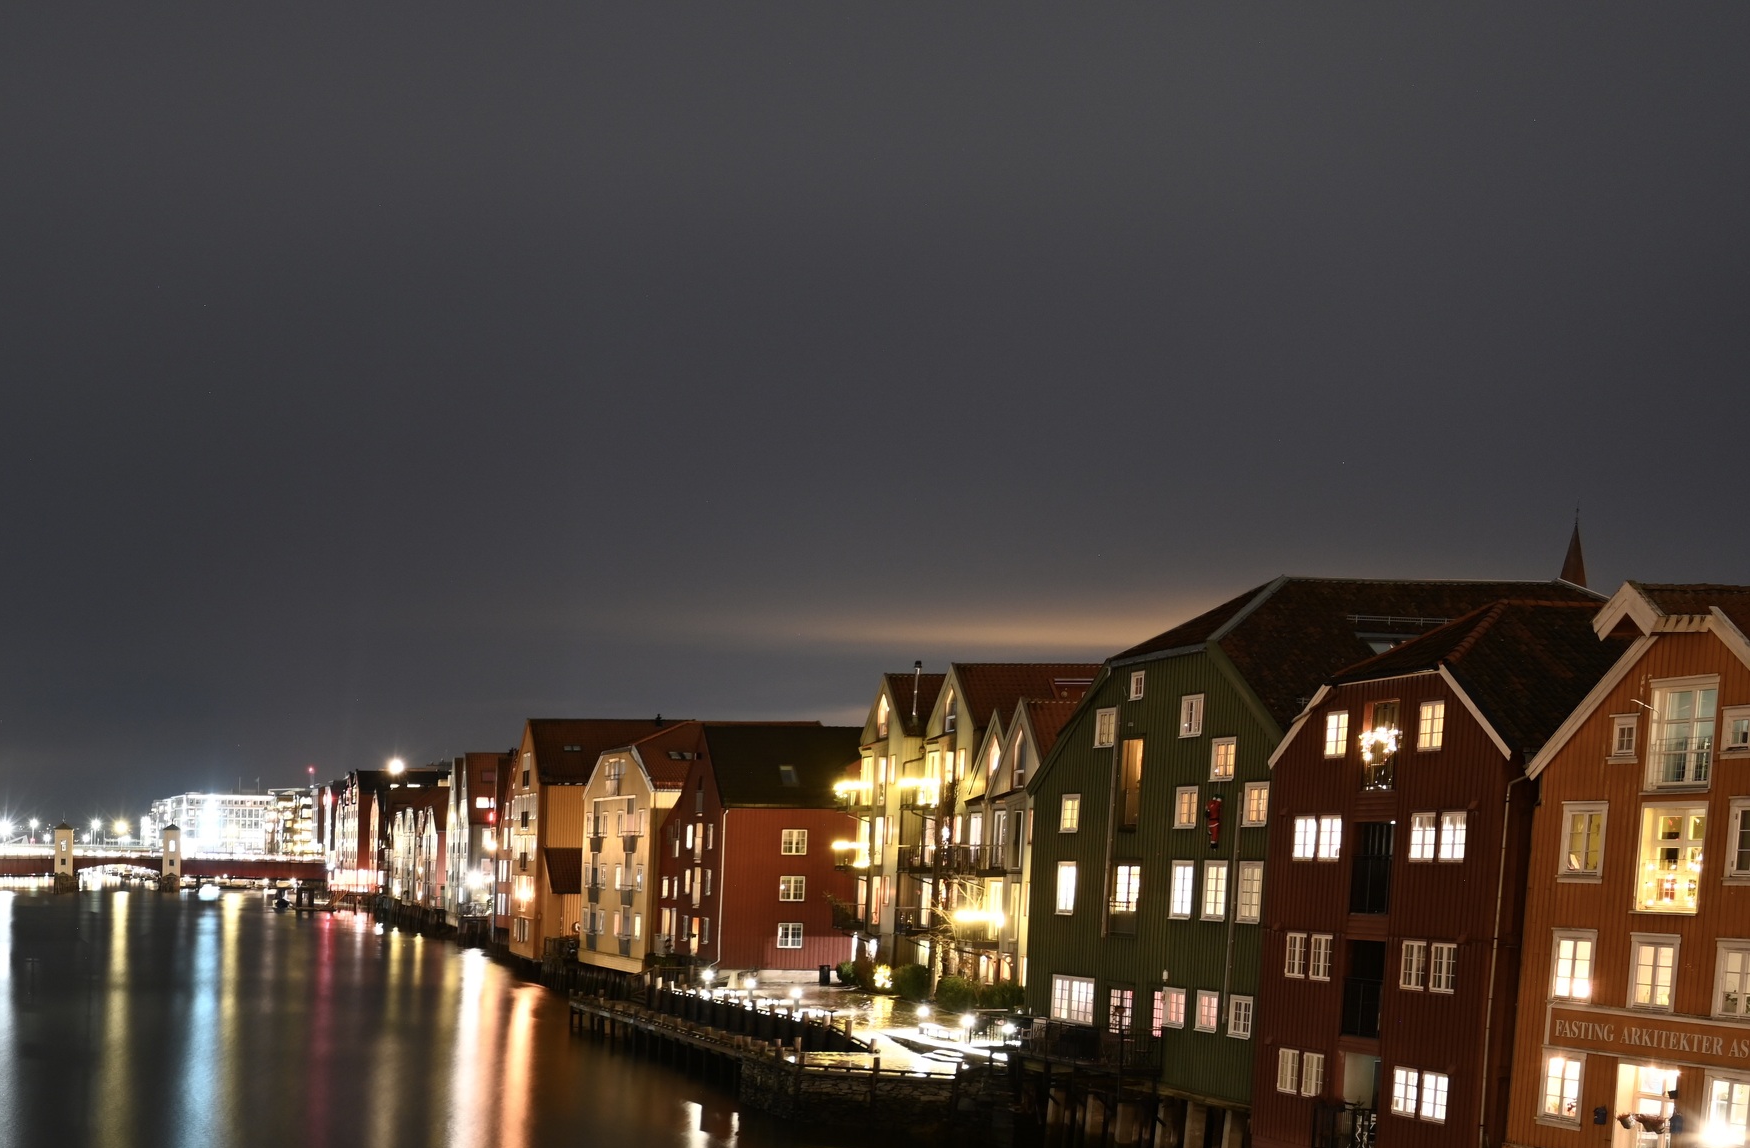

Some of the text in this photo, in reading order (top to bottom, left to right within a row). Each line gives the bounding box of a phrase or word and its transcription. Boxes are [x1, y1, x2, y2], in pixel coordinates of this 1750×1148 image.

[1555, 1019, 1750, 1059] FASTING ARKITEKTER AS
